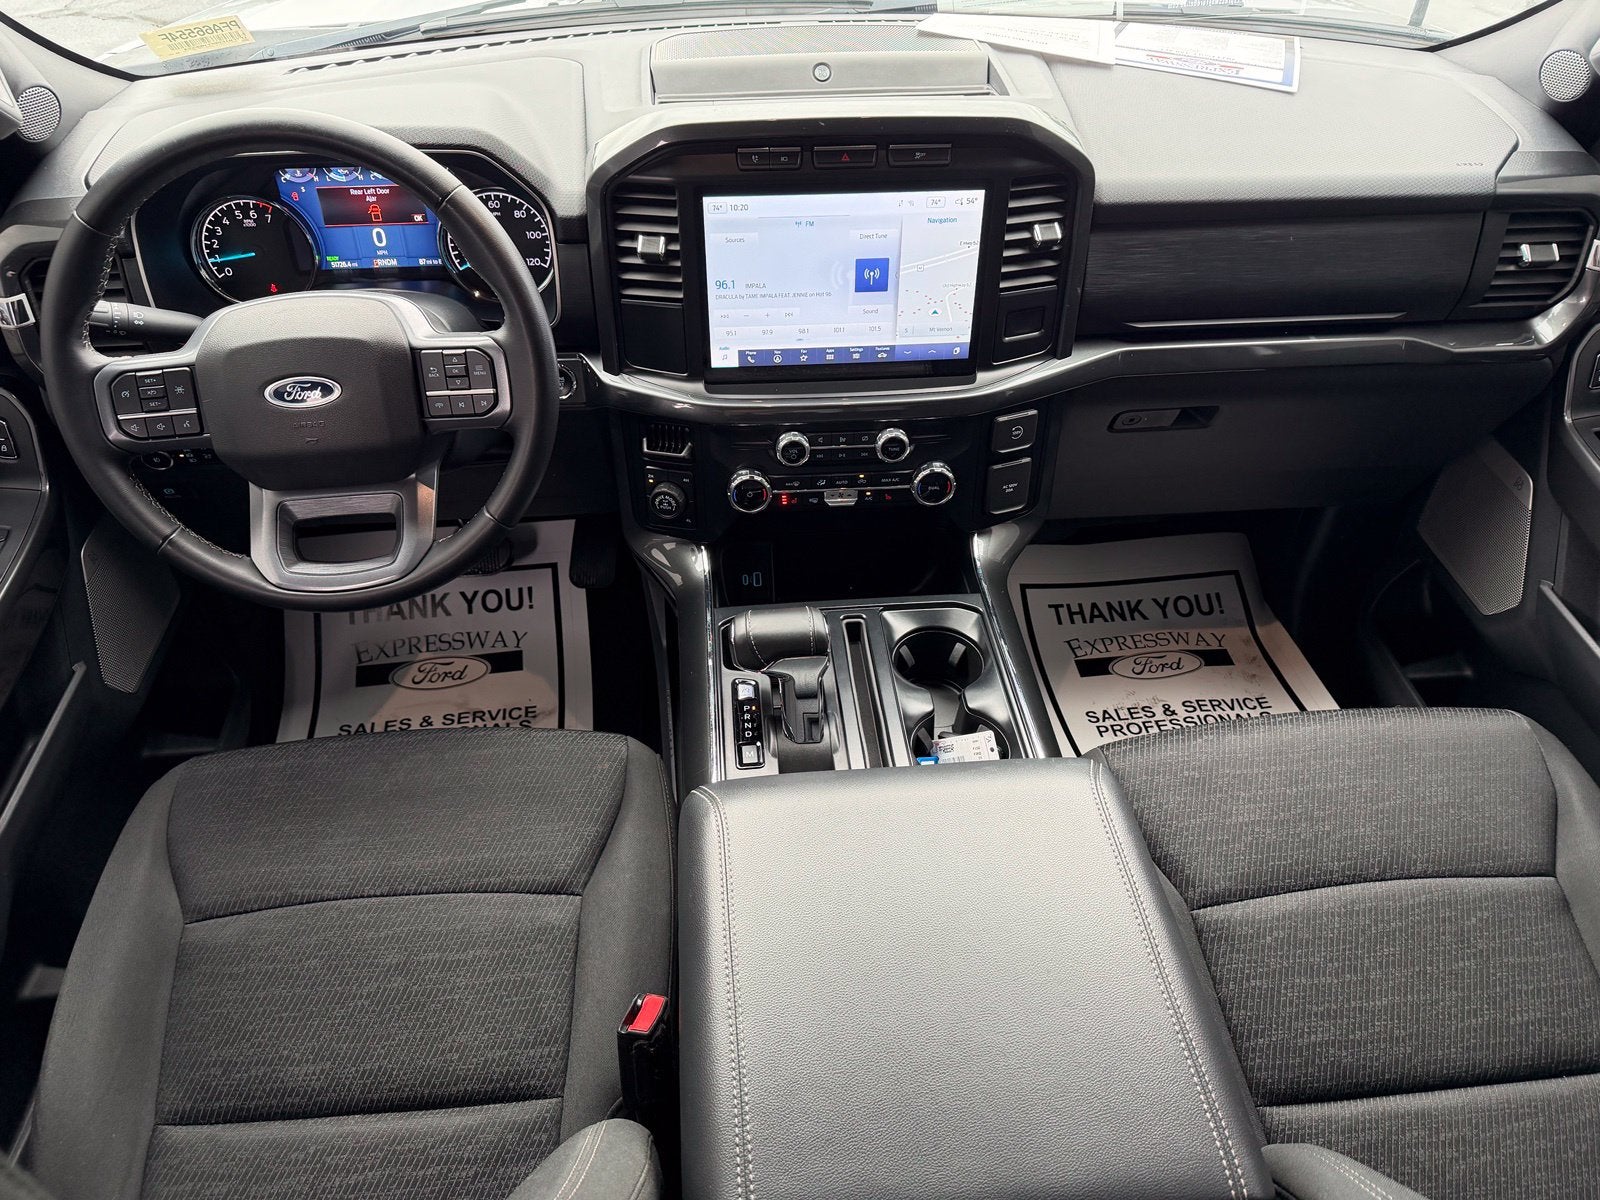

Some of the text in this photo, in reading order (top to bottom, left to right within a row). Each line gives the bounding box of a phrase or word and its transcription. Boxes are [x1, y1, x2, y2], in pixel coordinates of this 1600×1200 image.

[234, 211, 242, 219] 5
[250, 210, 258, 219] 6
[265, 214, 272, 223] 7
[514, 210, 527, 218] 80
[222, 217, 230, 225] 4
[927, 217, 958, 225] Navigation
[214, 226, 222, 235] 3
[525, 231, 542, 239] 100
[372, 228, 387, 247] 0
[211, 240, 219, 248] 2
[526, 258, 541, 266] 120
[224, 267, 233, 276] 0
[715, 280, 736, 290] 96.1
[459, 586, 535, 615] YOU!
[1047, 592, 1225, 625] THANK YOU!
[353, 630, 529, 664] EXPRESSWAY
[1064, 631, 1228, 659] EXPRESSWAY
[1131, 654, 1185, 676] Ford
[411, 660, 468, 685] Ford
[1085, 696, 1273, 724] SALES & SERVICE
[418, 715, 434, 728] &
[441, 705, 538, 727] SERVICE
[1096, 711, 1272, 738] PROFESSIO
[745, 730, 753, 738] D
